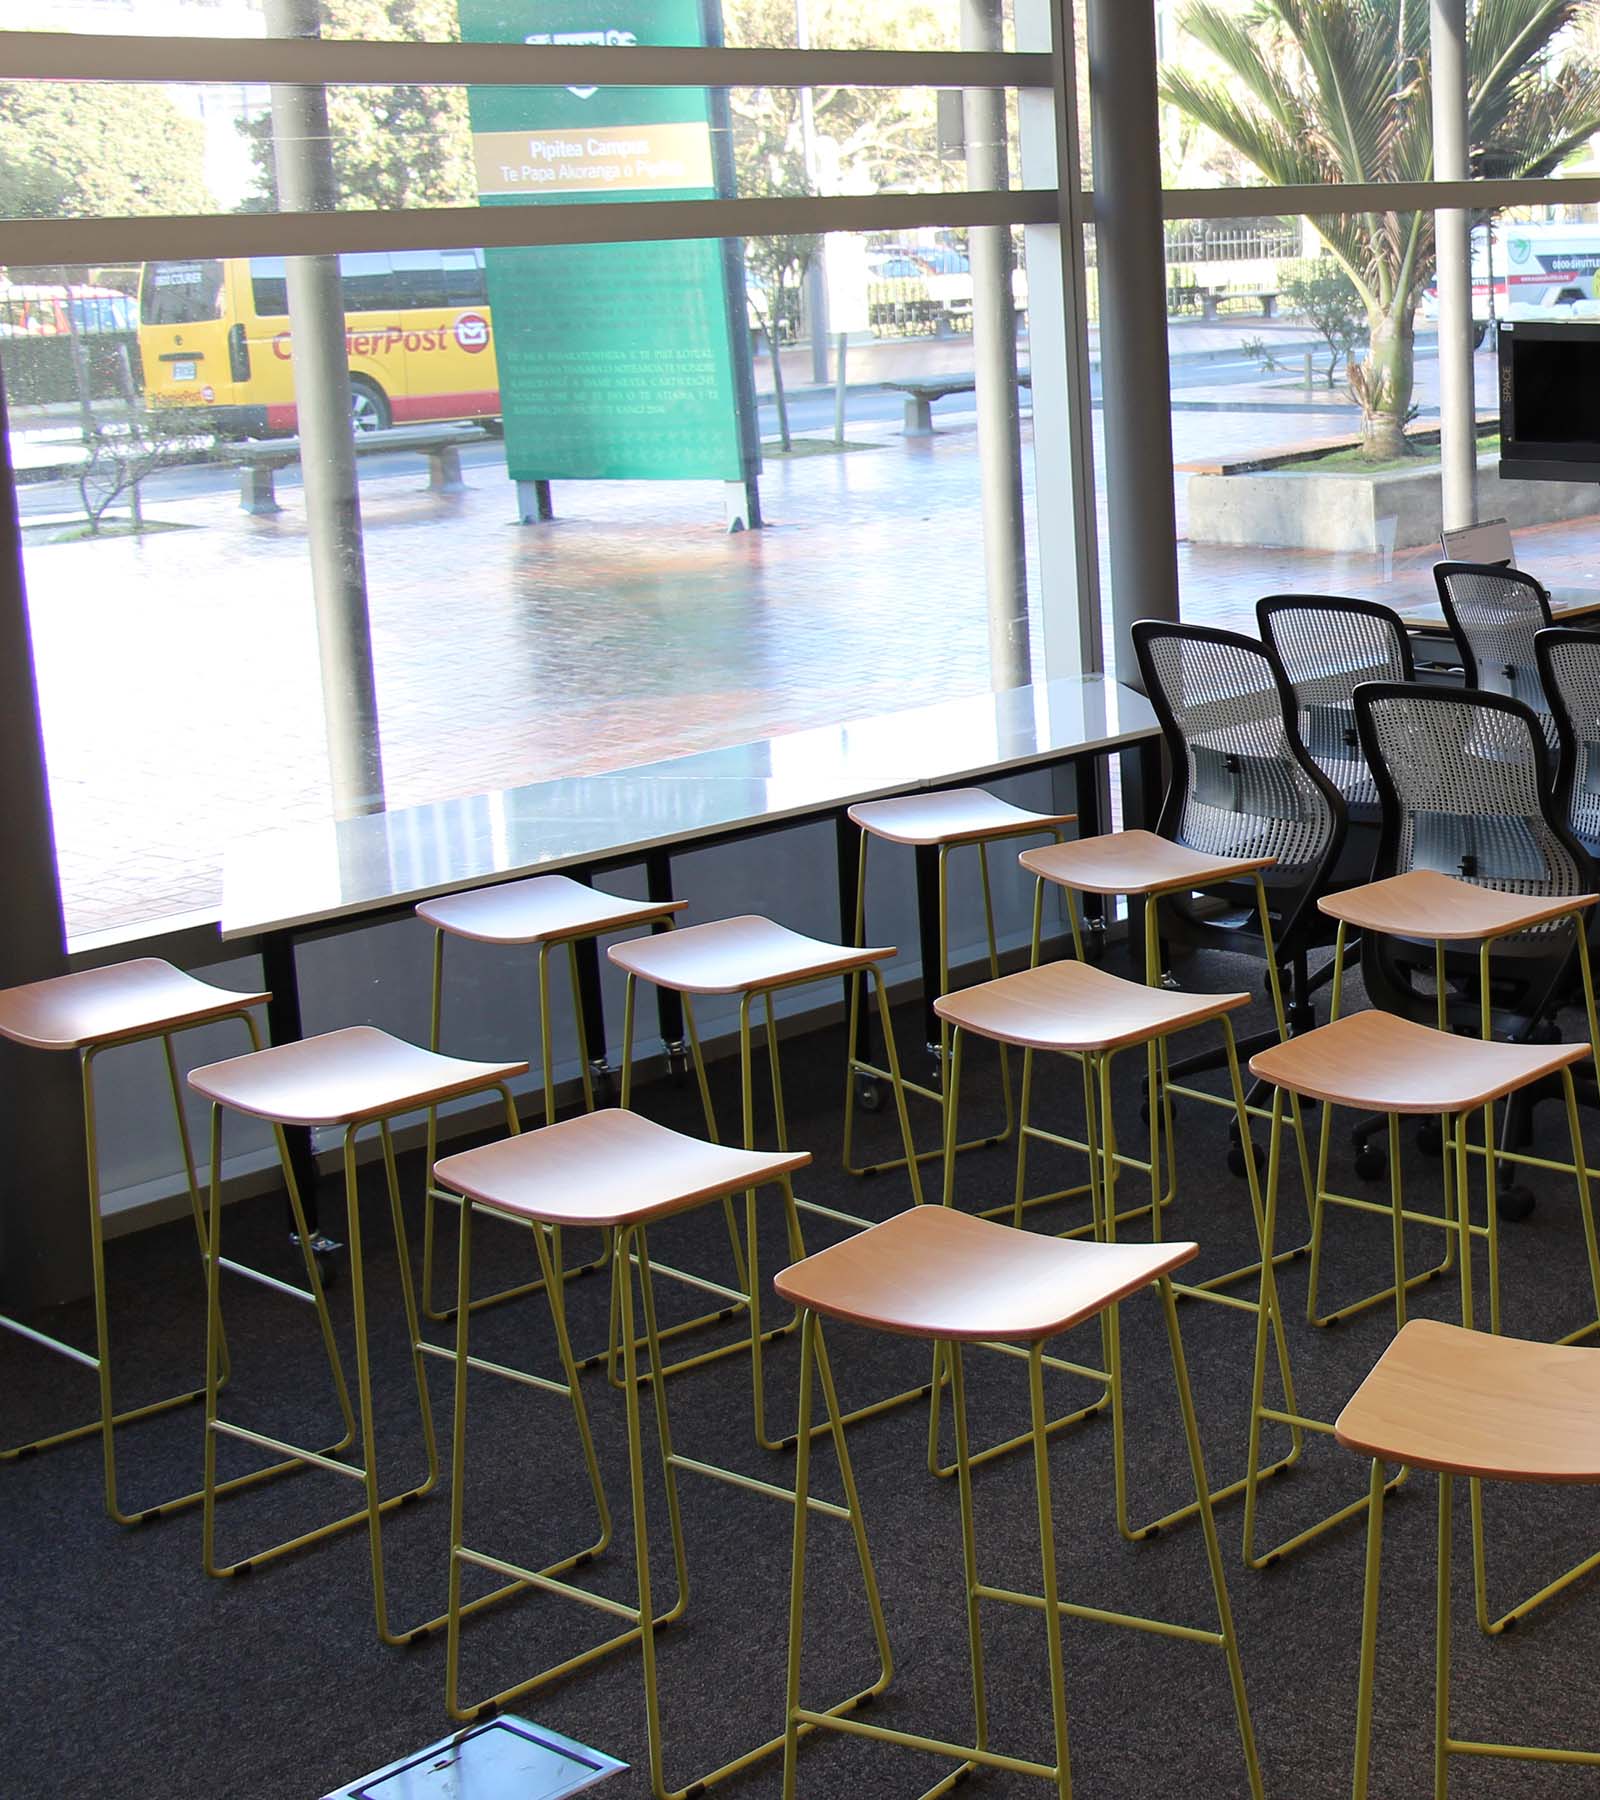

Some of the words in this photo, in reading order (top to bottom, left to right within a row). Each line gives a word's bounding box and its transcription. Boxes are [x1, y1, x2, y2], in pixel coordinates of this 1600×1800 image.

[530, 139, 583, 160] Pipitea
[587, 137, 651, 158] Campus
[501, 166, 518, 182] Te
[521, 164, 555, 182] Papa
[559, 162, 620, 181] Akoranga
[1502, 366, 1512, 402] SPACE
